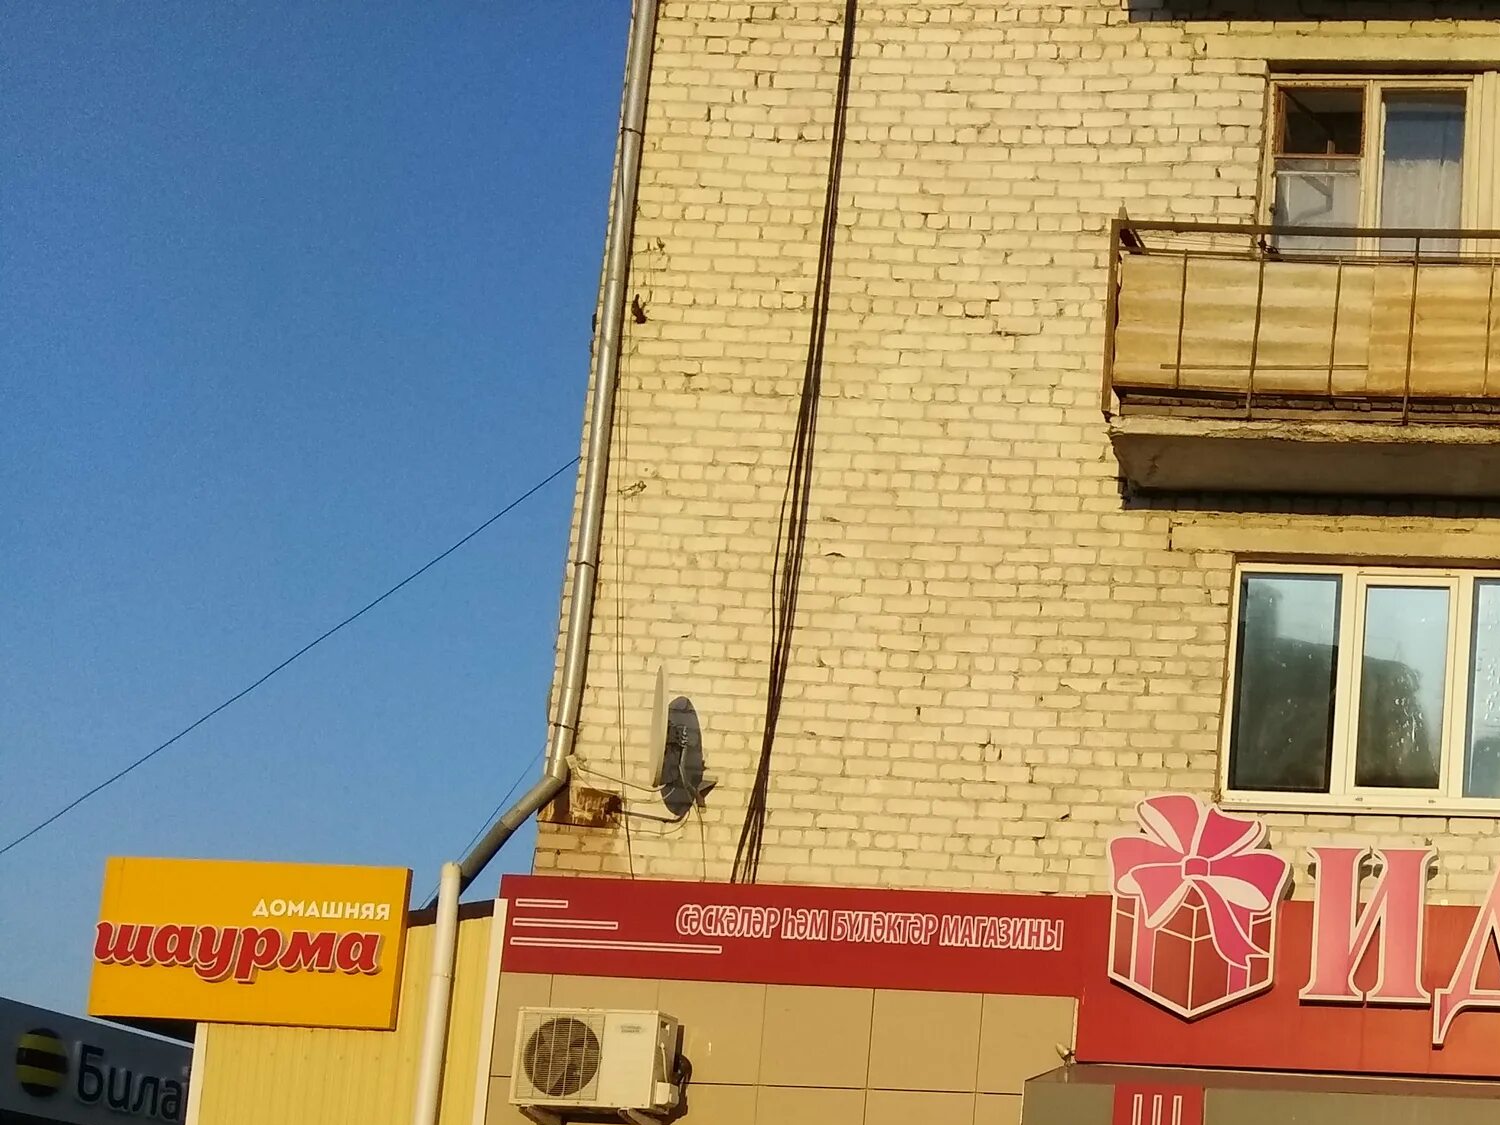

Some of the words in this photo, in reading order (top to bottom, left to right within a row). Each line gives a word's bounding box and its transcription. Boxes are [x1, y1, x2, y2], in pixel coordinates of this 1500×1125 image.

[252, 898, 391, 921] ДОМАШНЯЯ
[939, 914, 1064, 951] МАГАЗИНЫ
[94, 920, 384, 983] шаурма
[75, 1041, 189, 1122] Била
